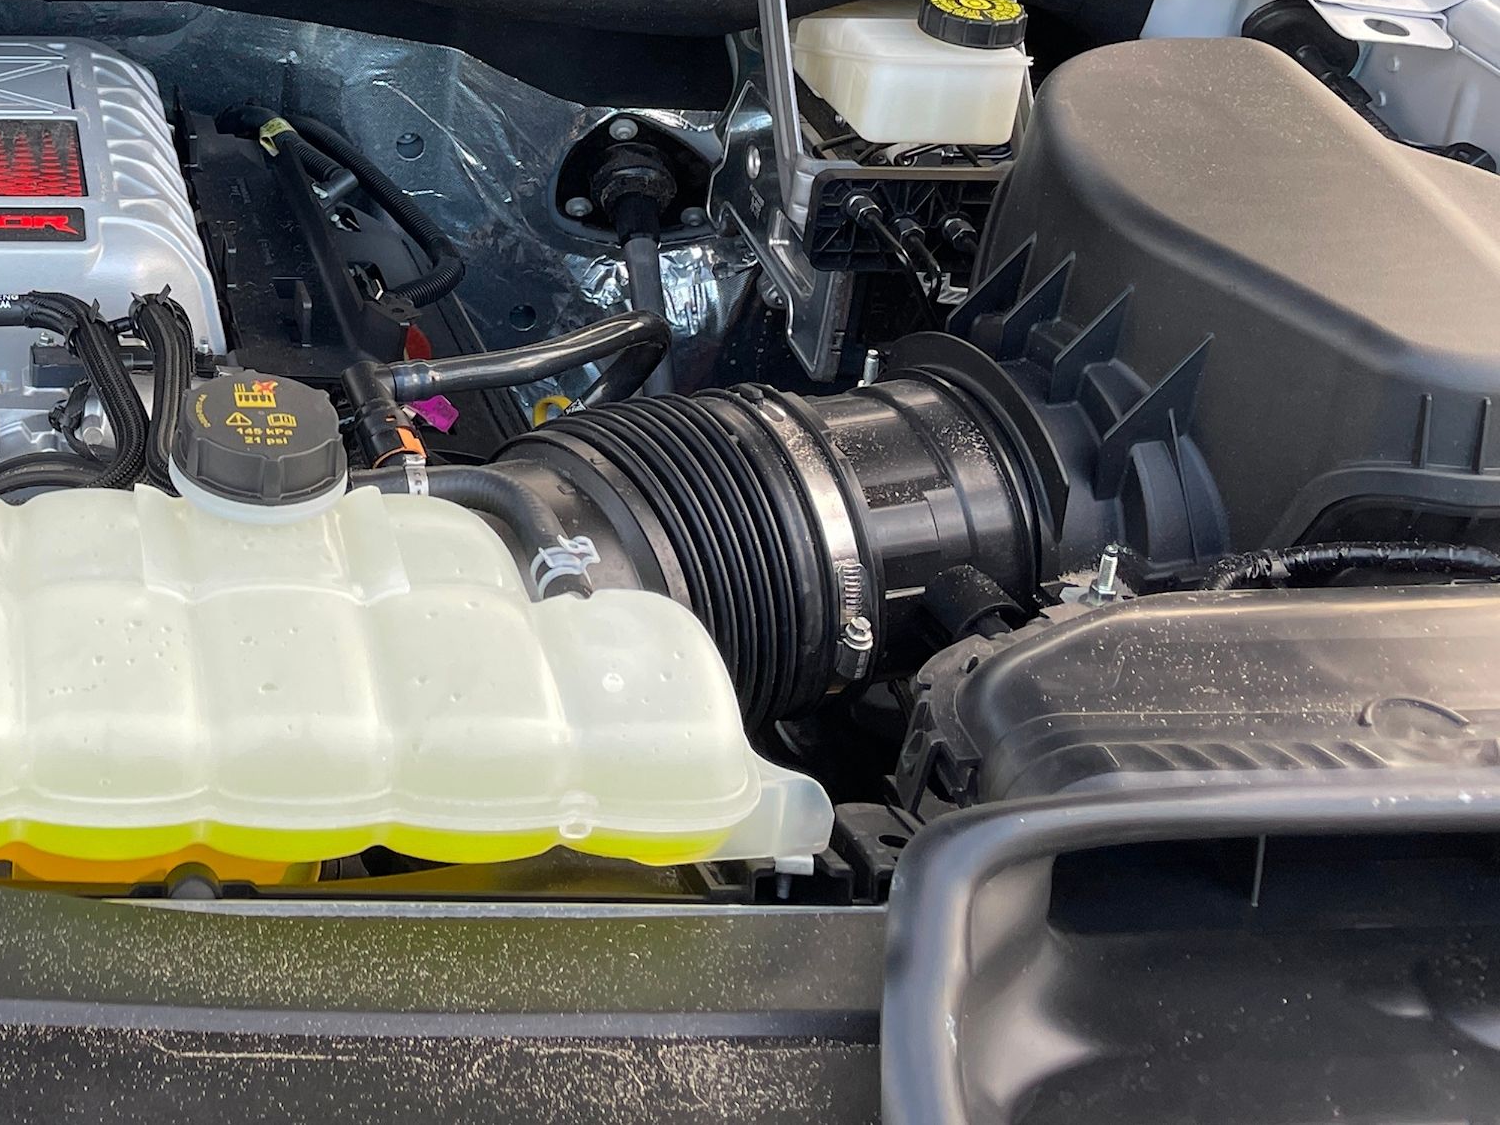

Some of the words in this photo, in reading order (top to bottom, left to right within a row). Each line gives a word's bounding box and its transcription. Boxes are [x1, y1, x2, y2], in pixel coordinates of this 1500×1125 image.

[236, 427, 263, 436] 145
[266, 427, 293, 436] kPa
[244, 435, 261, 444] 21
[266, 436, 288, 446] psi
